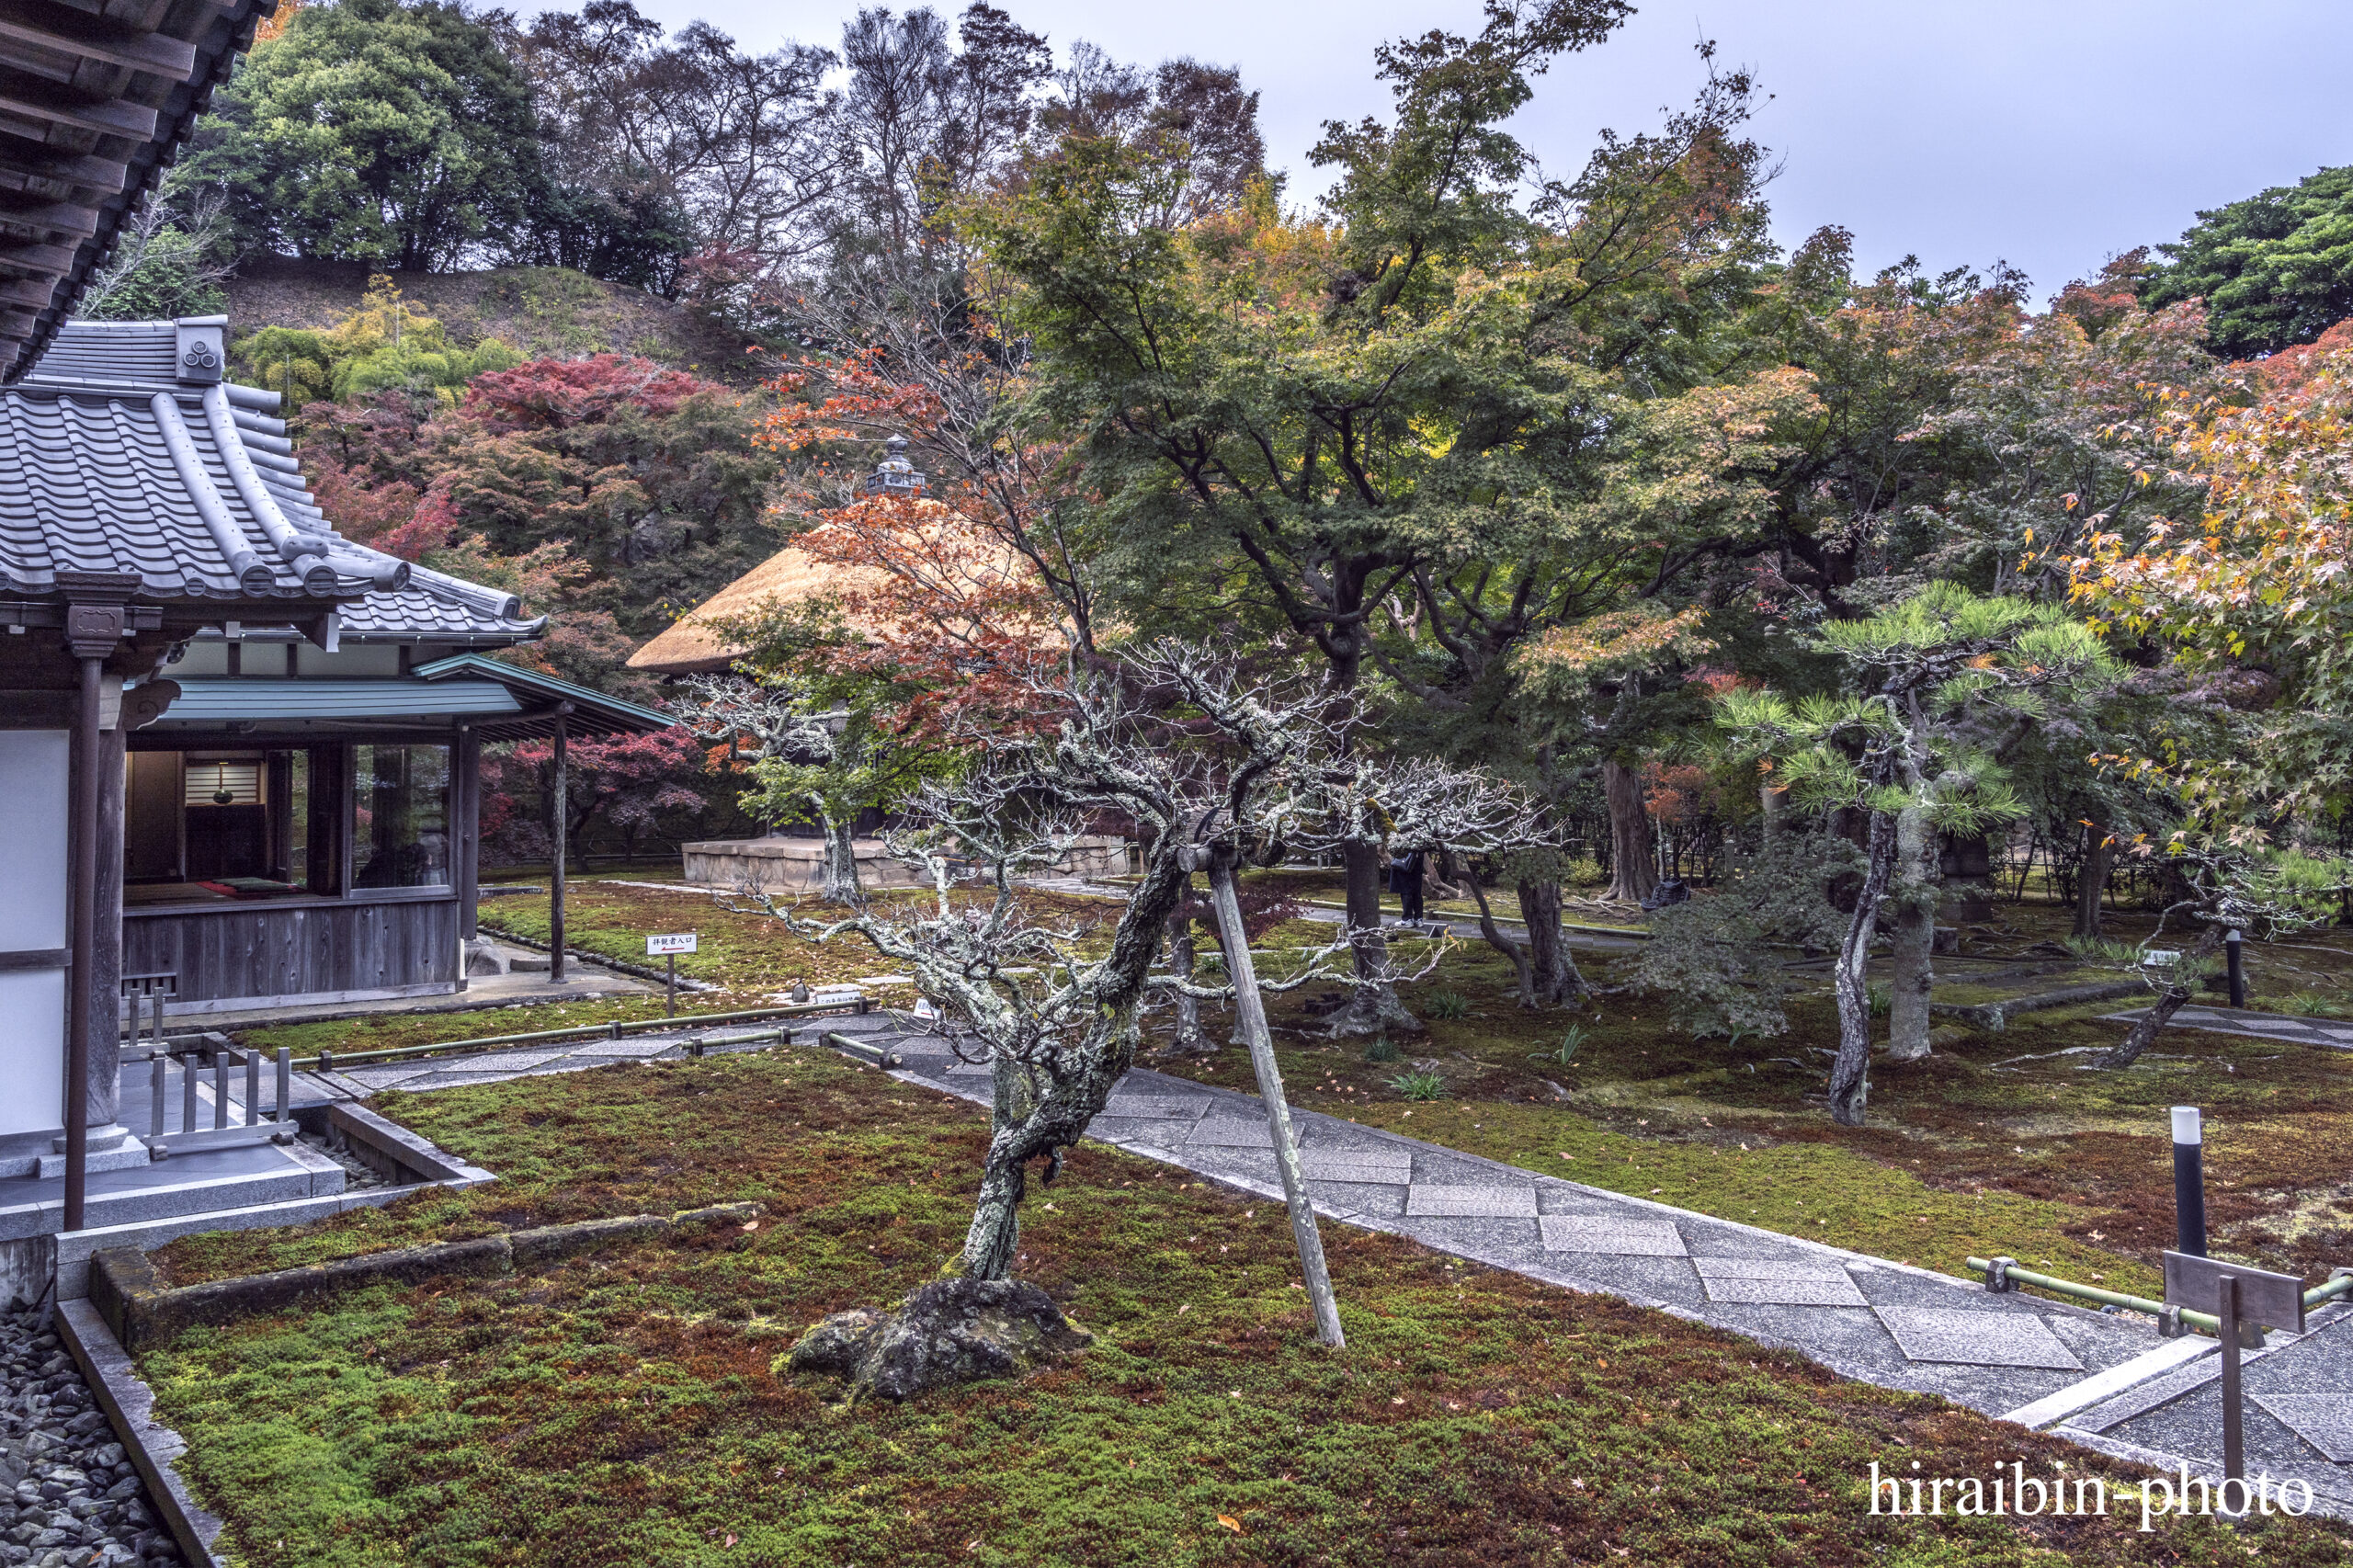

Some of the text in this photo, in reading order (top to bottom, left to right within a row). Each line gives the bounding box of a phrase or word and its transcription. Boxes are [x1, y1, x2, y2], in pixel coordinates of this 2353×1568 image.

[653, 937, 692, 946] 拝観者入口
